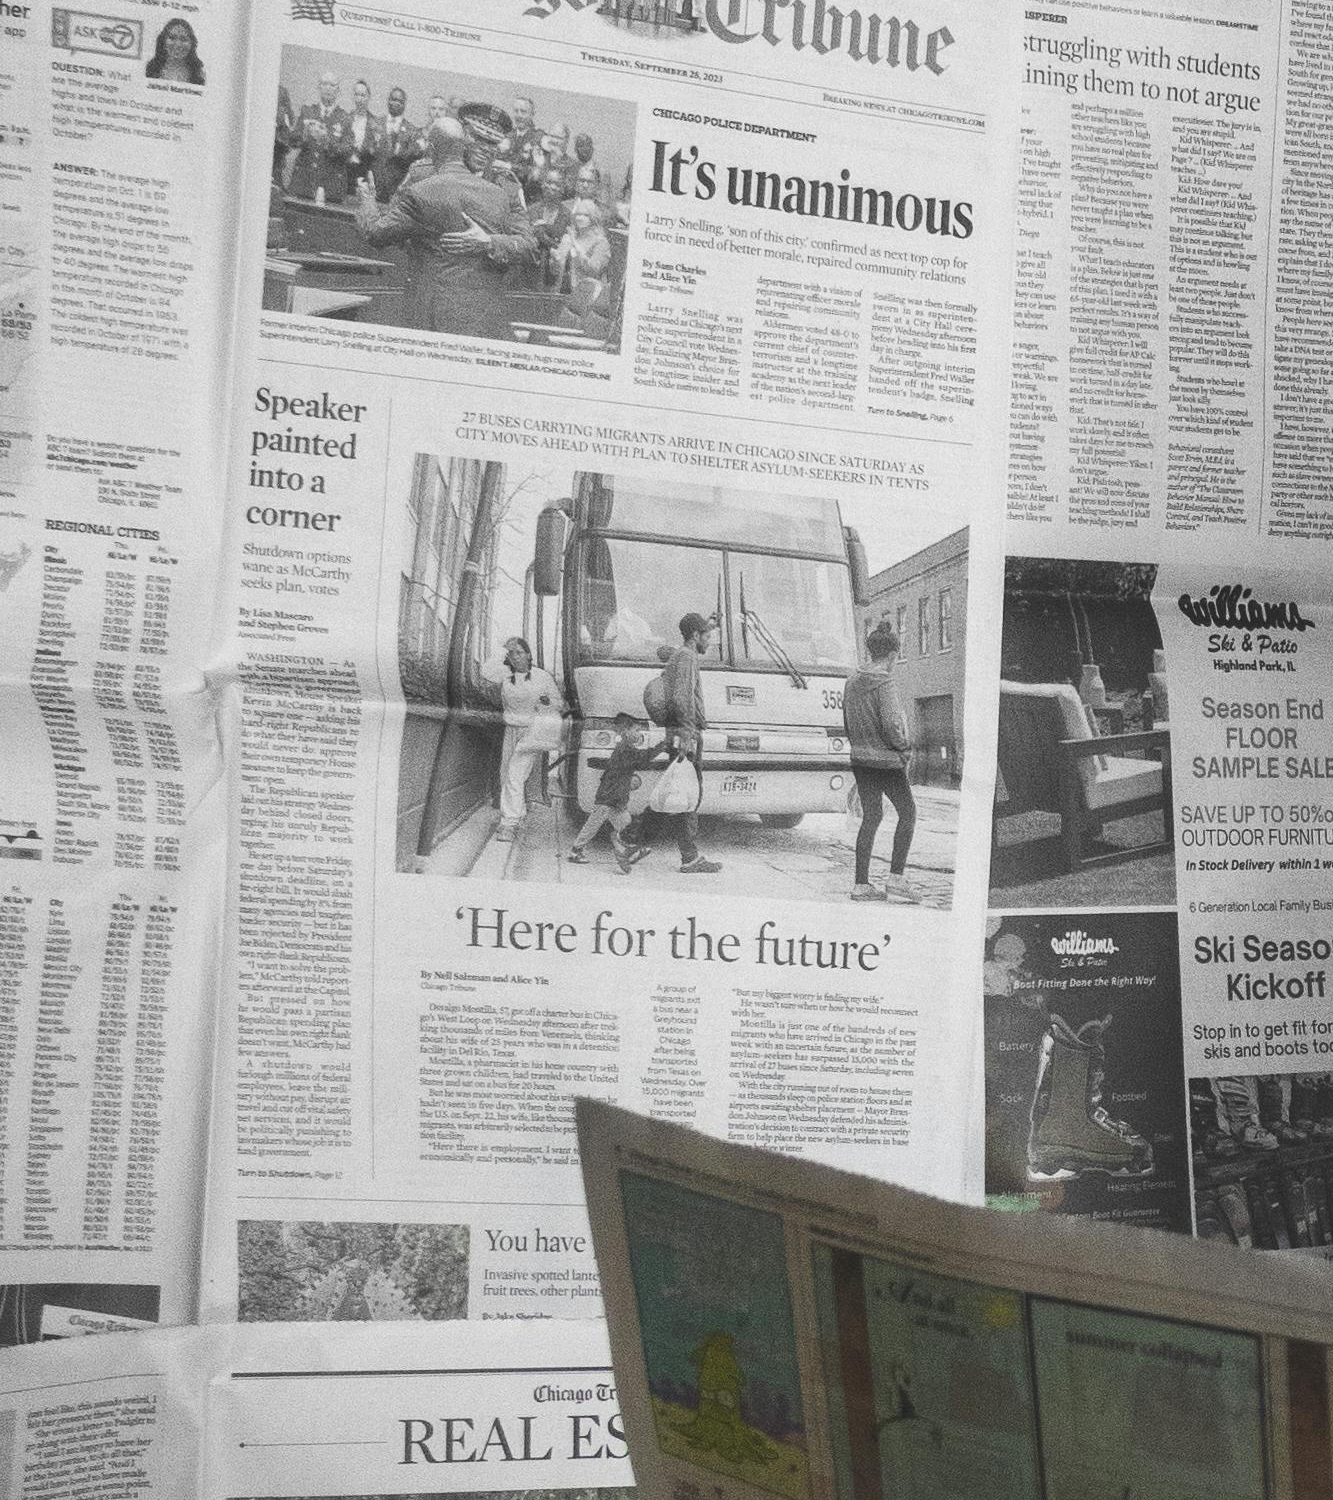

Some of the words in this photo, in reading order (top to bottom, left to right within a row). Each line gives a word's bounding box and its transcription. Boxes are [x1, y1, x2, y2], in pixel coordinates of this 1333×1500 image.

[652, 108, 702, 123] CHICAGO
[703, 116, 742, 130] POLICE
[744, 123, 817, 142] DEPARTMENT
[652, 141, 716, 199] It's
[727, 167, 974, 238] unanimous
[255, 387, 367, 423] Speaker
[251, 427, 357, 460] painted
[249, 460, 304, 490] into
[310, 475, 325, 494] a
[245, 506, 342, 532] corner
[1201, 696, 1280, 719] Season
[1286, 698, 1324, 720] End
[1226, 727, 1297, 749] FLOOR
[1193, 756, 1279, 778] SAMPLE
[454, 906, 578, 954] 'Here
[592, 910, 656, 958] for
[669, 916, 741, 964] the
[756, 920, 891, 972] future'
[1195, 936, 1235, 963] Ski
[1227, 971, 1325, 1001] Kickoff
[401, 1416, 552, 1465] REAL
